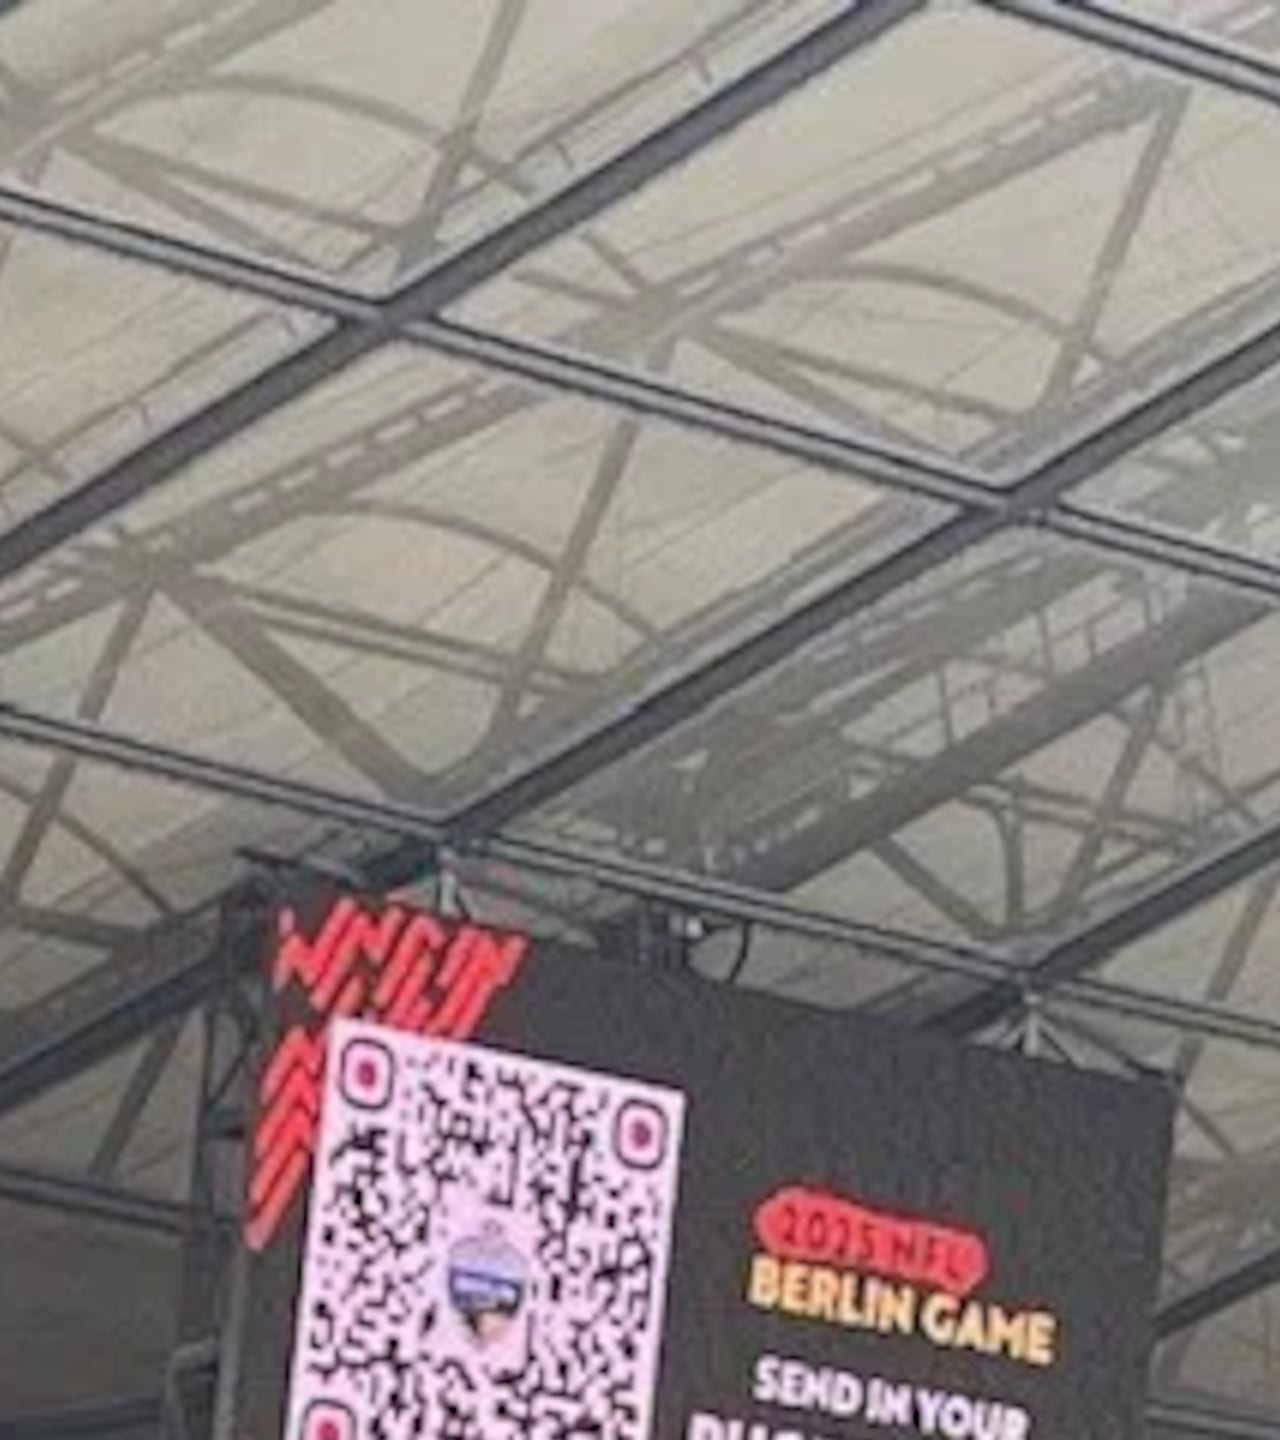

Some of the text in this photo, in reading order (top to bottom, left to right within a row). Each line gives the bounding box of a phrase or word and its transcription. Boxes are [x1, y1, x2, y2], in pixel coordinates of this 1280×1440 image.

[780, 1203, 970, 1279] 2025 NFL
[748, 1253, 1058, 1366] BERLIN GAME
[753, 1354, 863, 1417] SEND
[865, 1377, 911, 1426] IN
